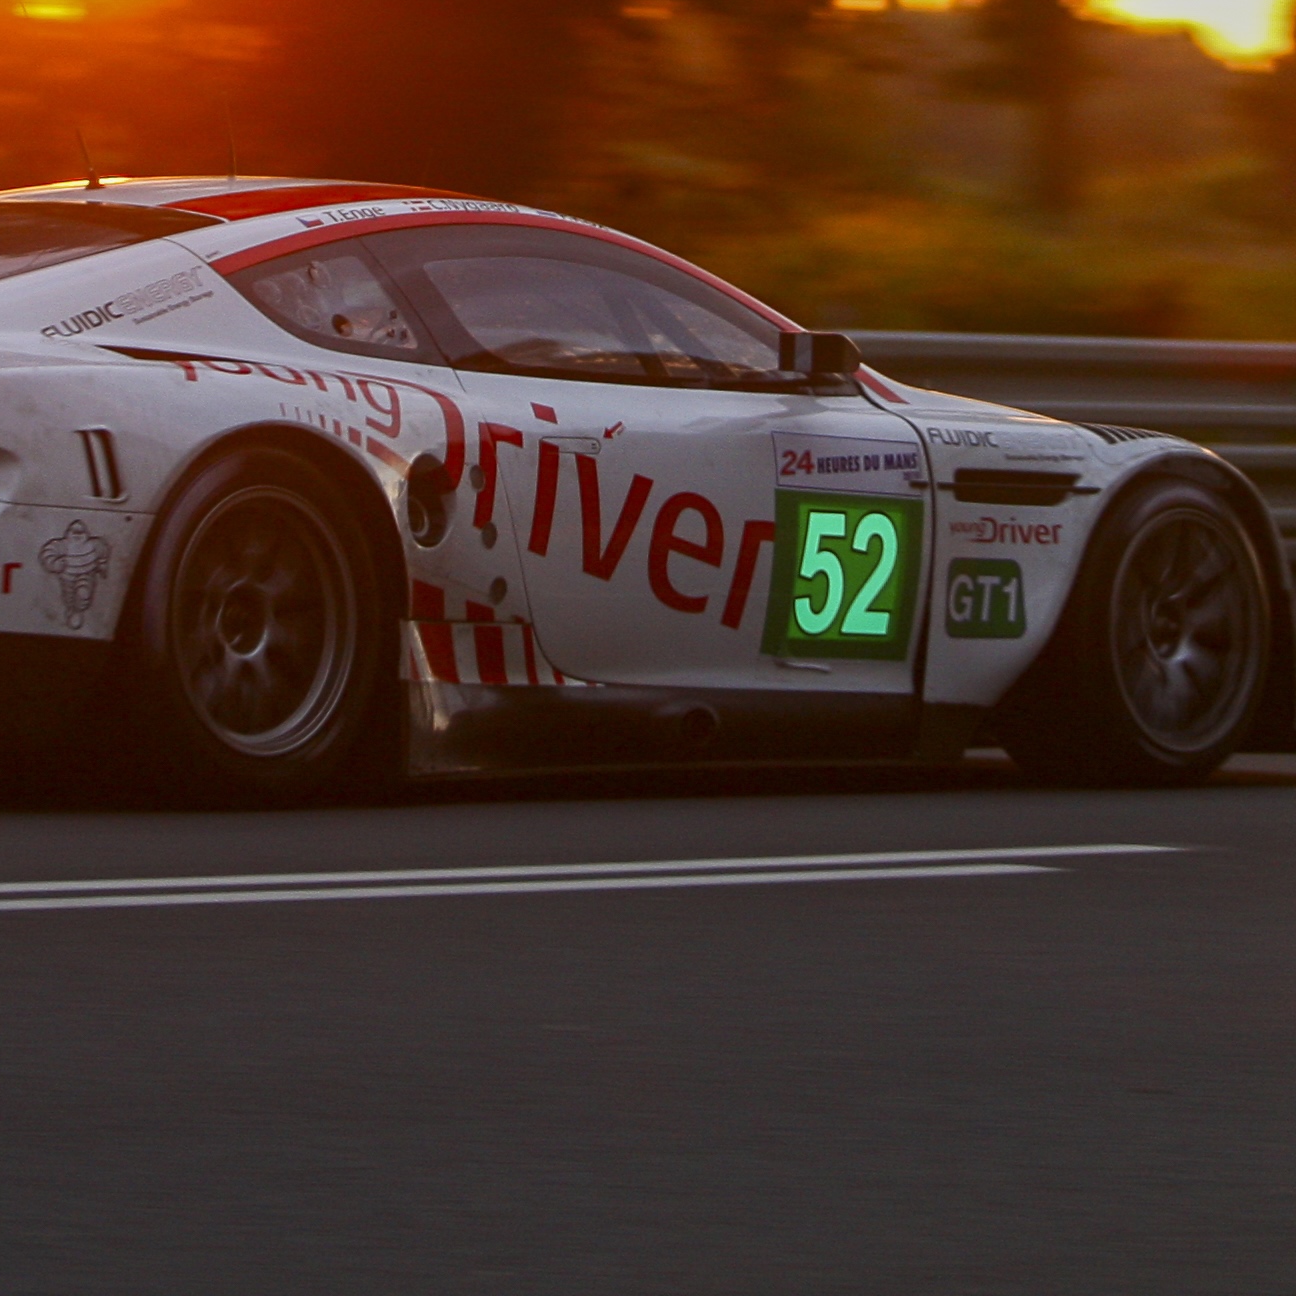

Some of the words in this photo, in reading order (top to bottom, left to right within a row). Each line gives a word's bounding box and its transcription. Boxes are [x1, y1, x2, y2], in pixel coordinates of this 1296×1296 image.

[926, 427, 1000, 448] FLUIDIC
[780, 449, 815, 476] 24
[817, 455, 860, 474] HEURES
[863, 454, 881, 471] DU
[884, 452, 917, 470] MANS
[794, 511, 898, 635] 52
[949, 573, 1021, 623] GT1
